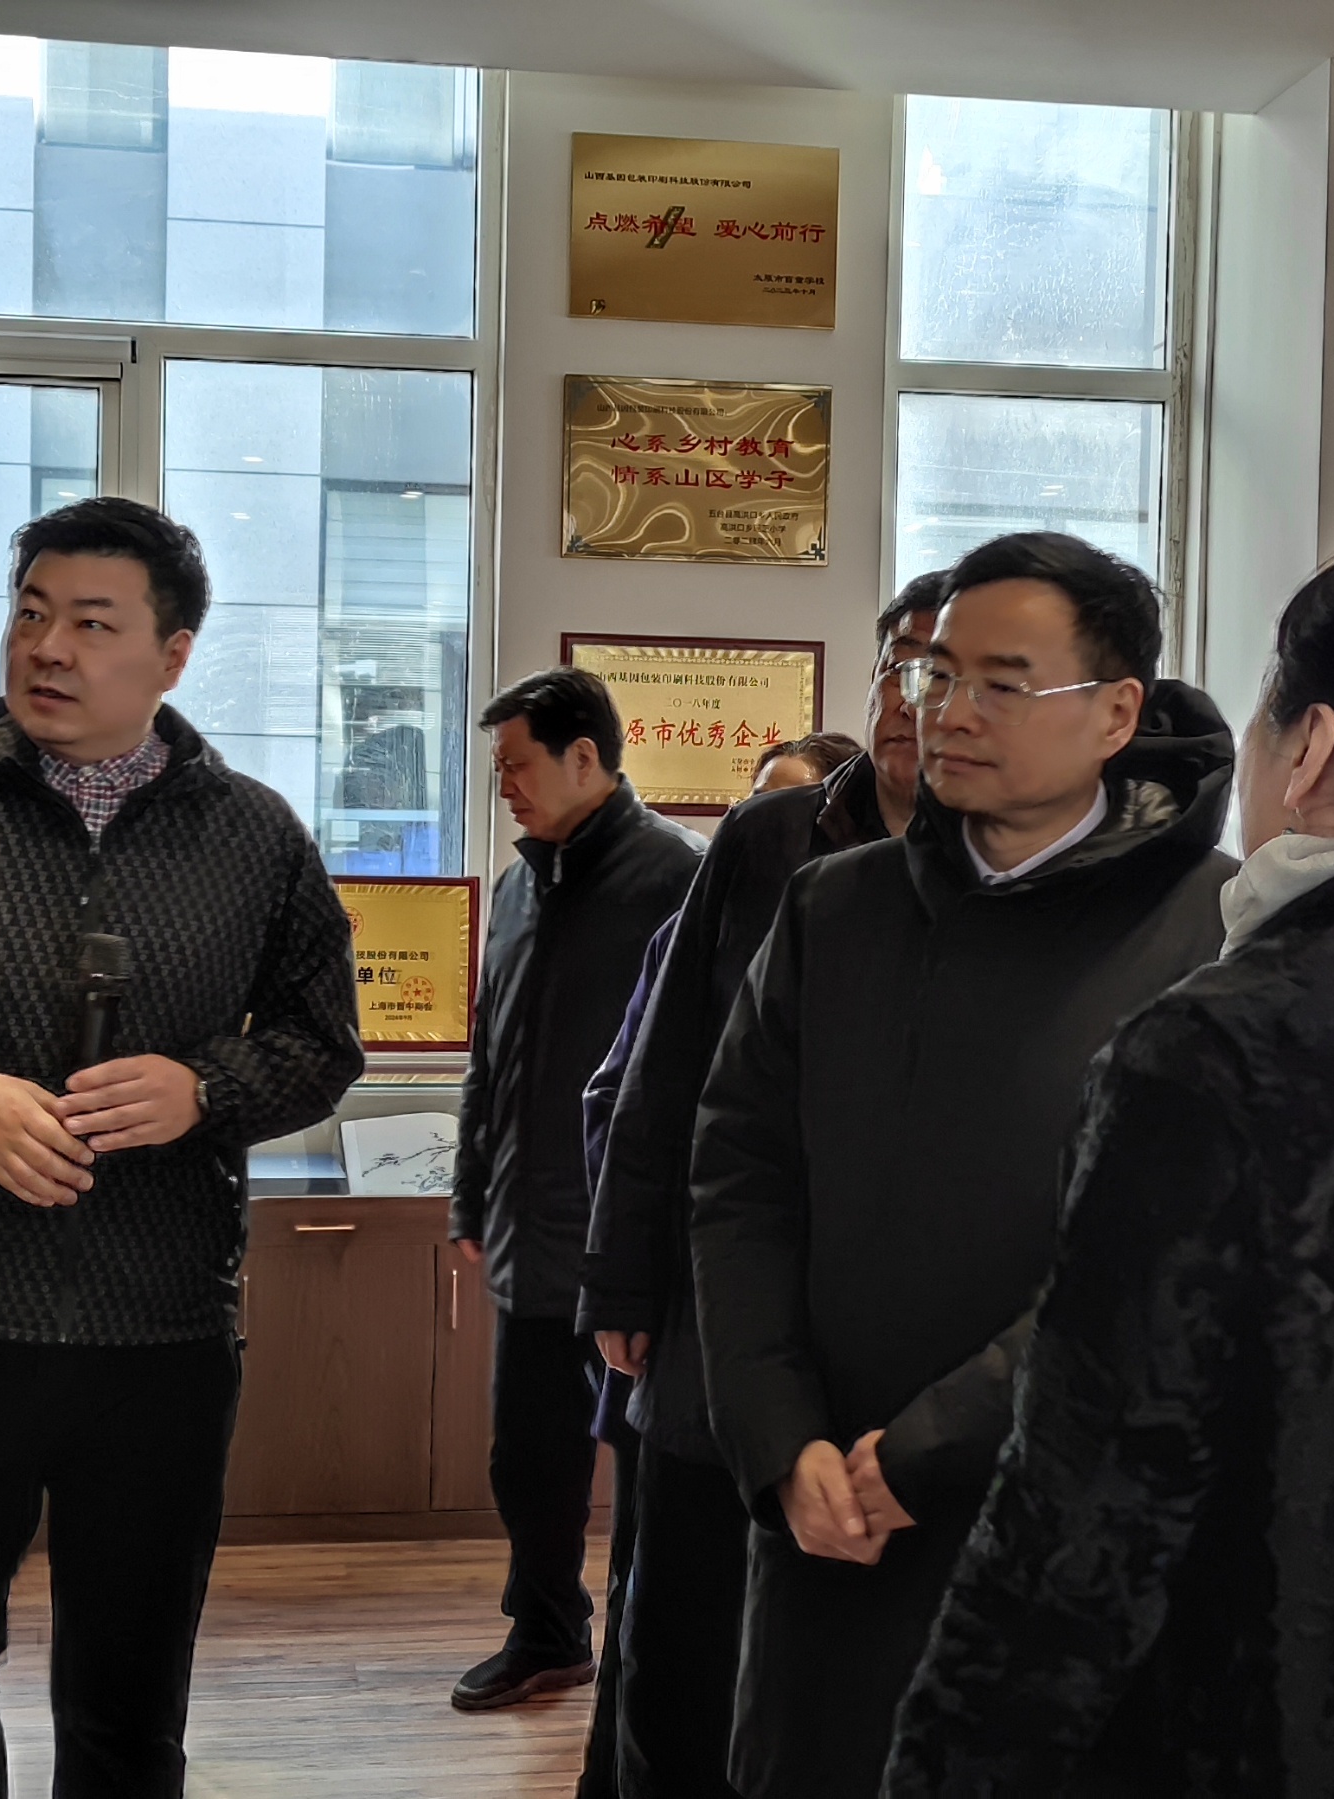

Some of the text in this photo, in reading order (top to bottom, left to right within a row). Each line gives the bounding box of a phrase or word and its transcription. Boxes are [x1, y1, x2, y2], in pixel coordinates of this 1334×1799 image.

[584, 211, 827, 244] 点燃希望 爱心前行
[610, 432, 795, 459] 心系乡村教育
[610, 464, 795, 490] 情系山区学子
[355, 966, 400, 986] 单位
